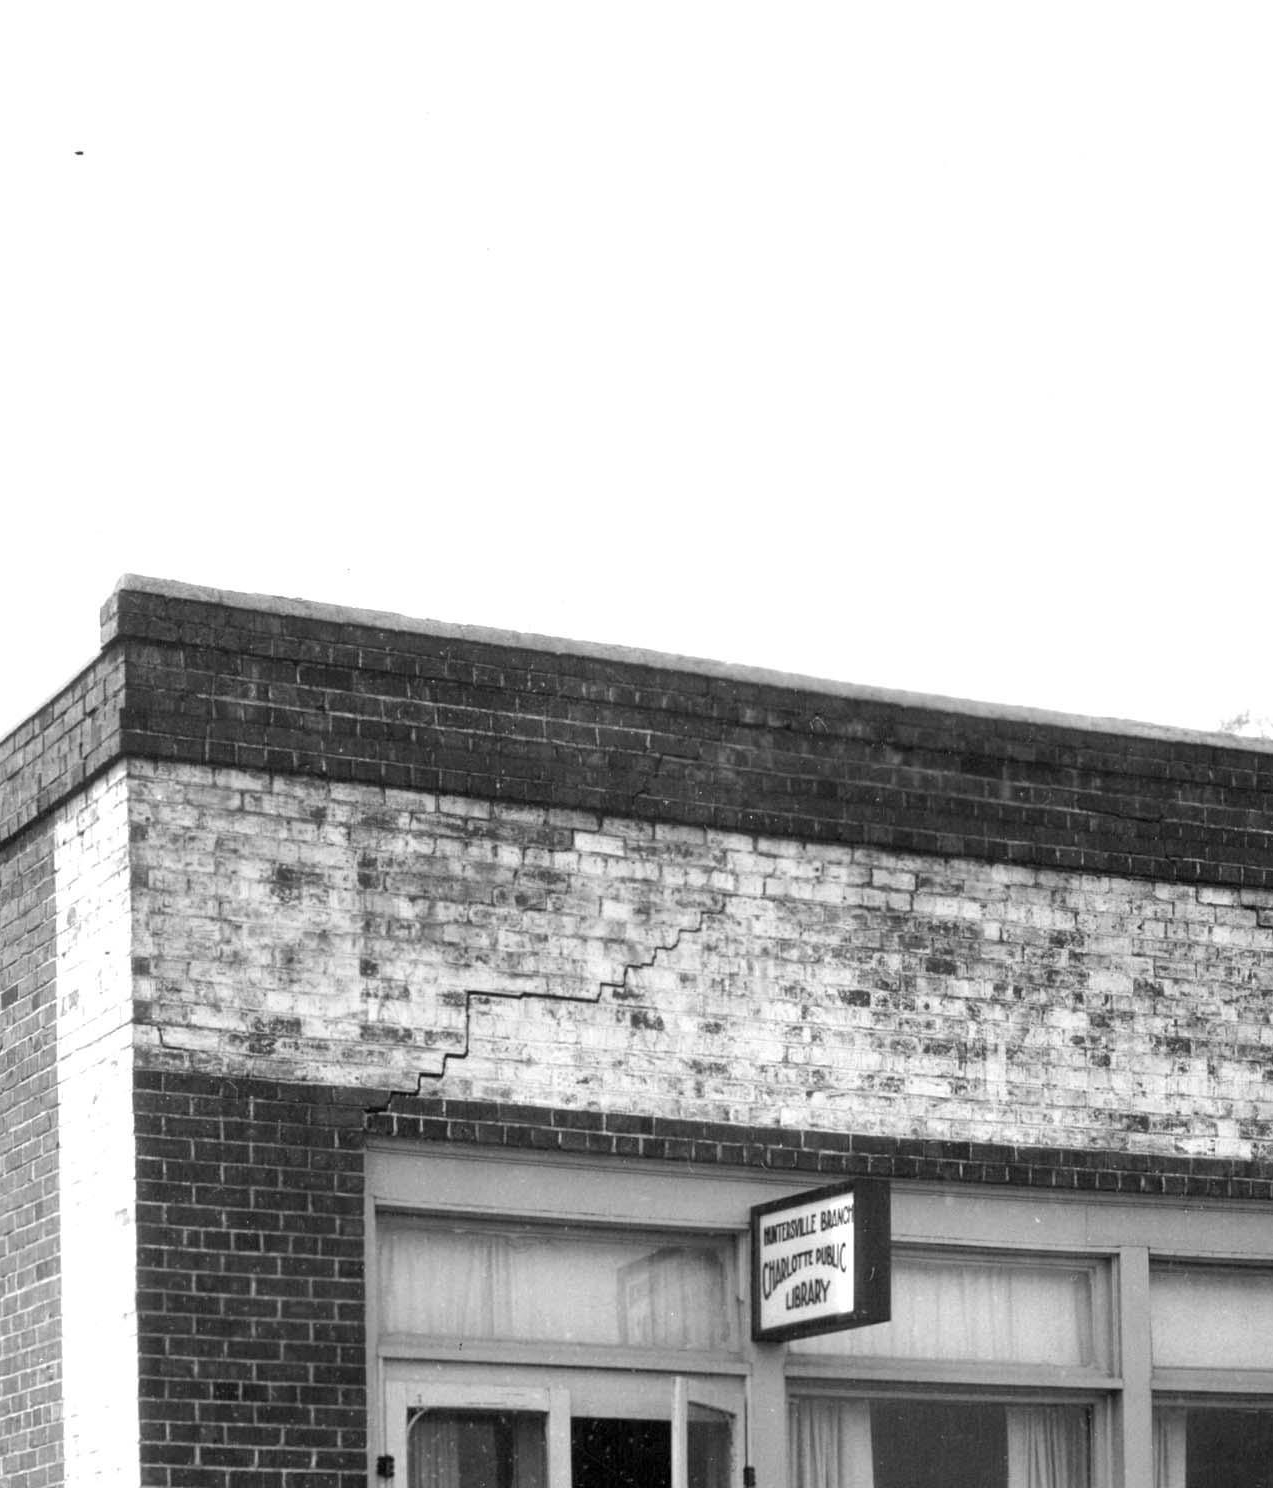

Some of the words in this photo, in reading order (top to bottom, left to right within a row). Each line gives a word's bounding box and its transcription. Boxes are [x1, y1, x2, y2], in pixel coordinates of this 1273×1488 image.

[763, 1214, 817, 1246] HUNTERSVILLE
[820, 1203, 854, 1231] BRANCH
[762, 1250, 814, 1301] CHARLOTTE
[815, 1243, 847, 1273] PUBLIC
[785, 1278, 831, 1311] LIBRARY
